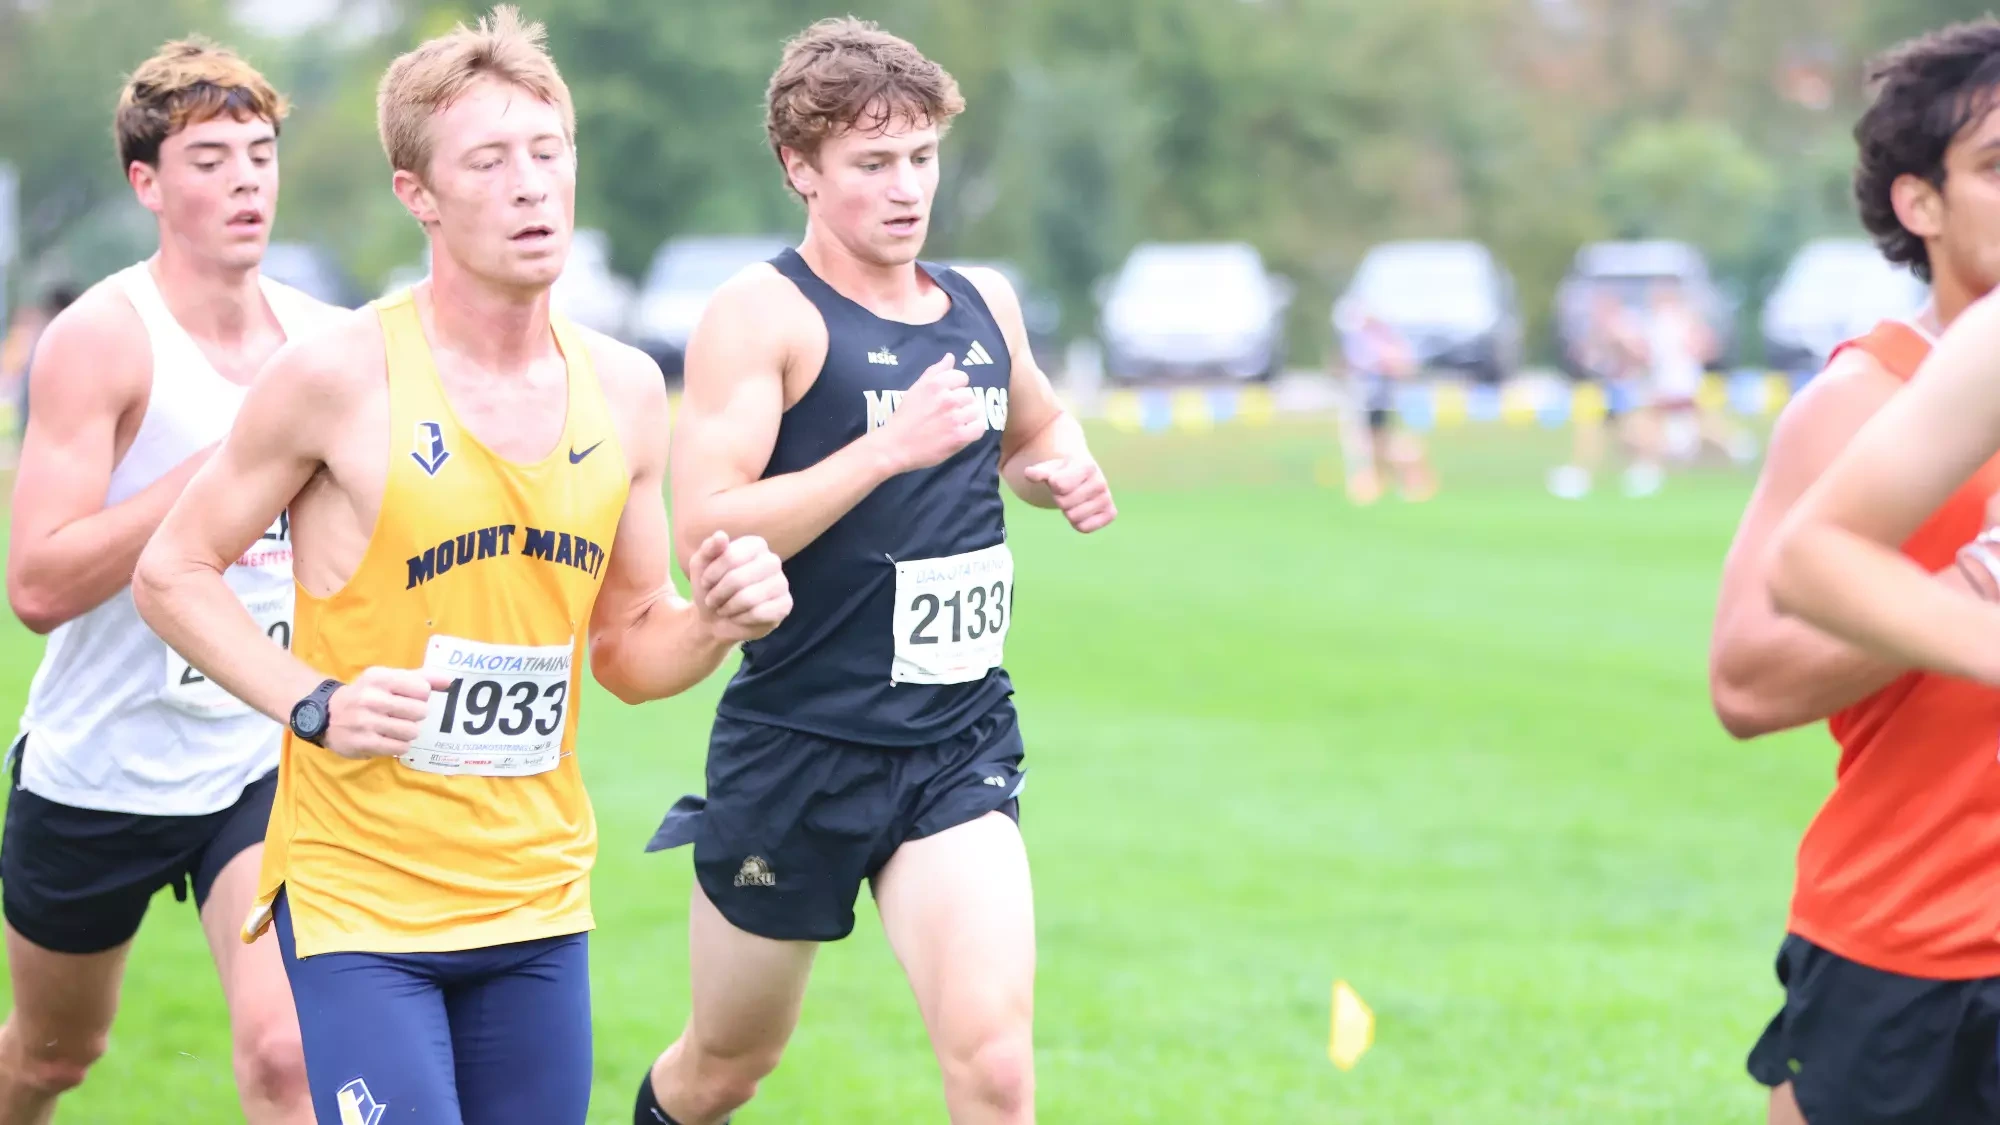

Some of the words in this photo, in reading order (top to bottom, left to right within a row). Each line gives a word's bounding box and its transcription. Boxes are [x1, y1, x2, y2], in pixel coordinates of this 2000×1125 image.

[406, 524, 516, 590] MOUNT
[521, 526, 605, 580] MARTY
[909, 580, 1005, 645] 2133
[439, 677, 568, 736] 1933
